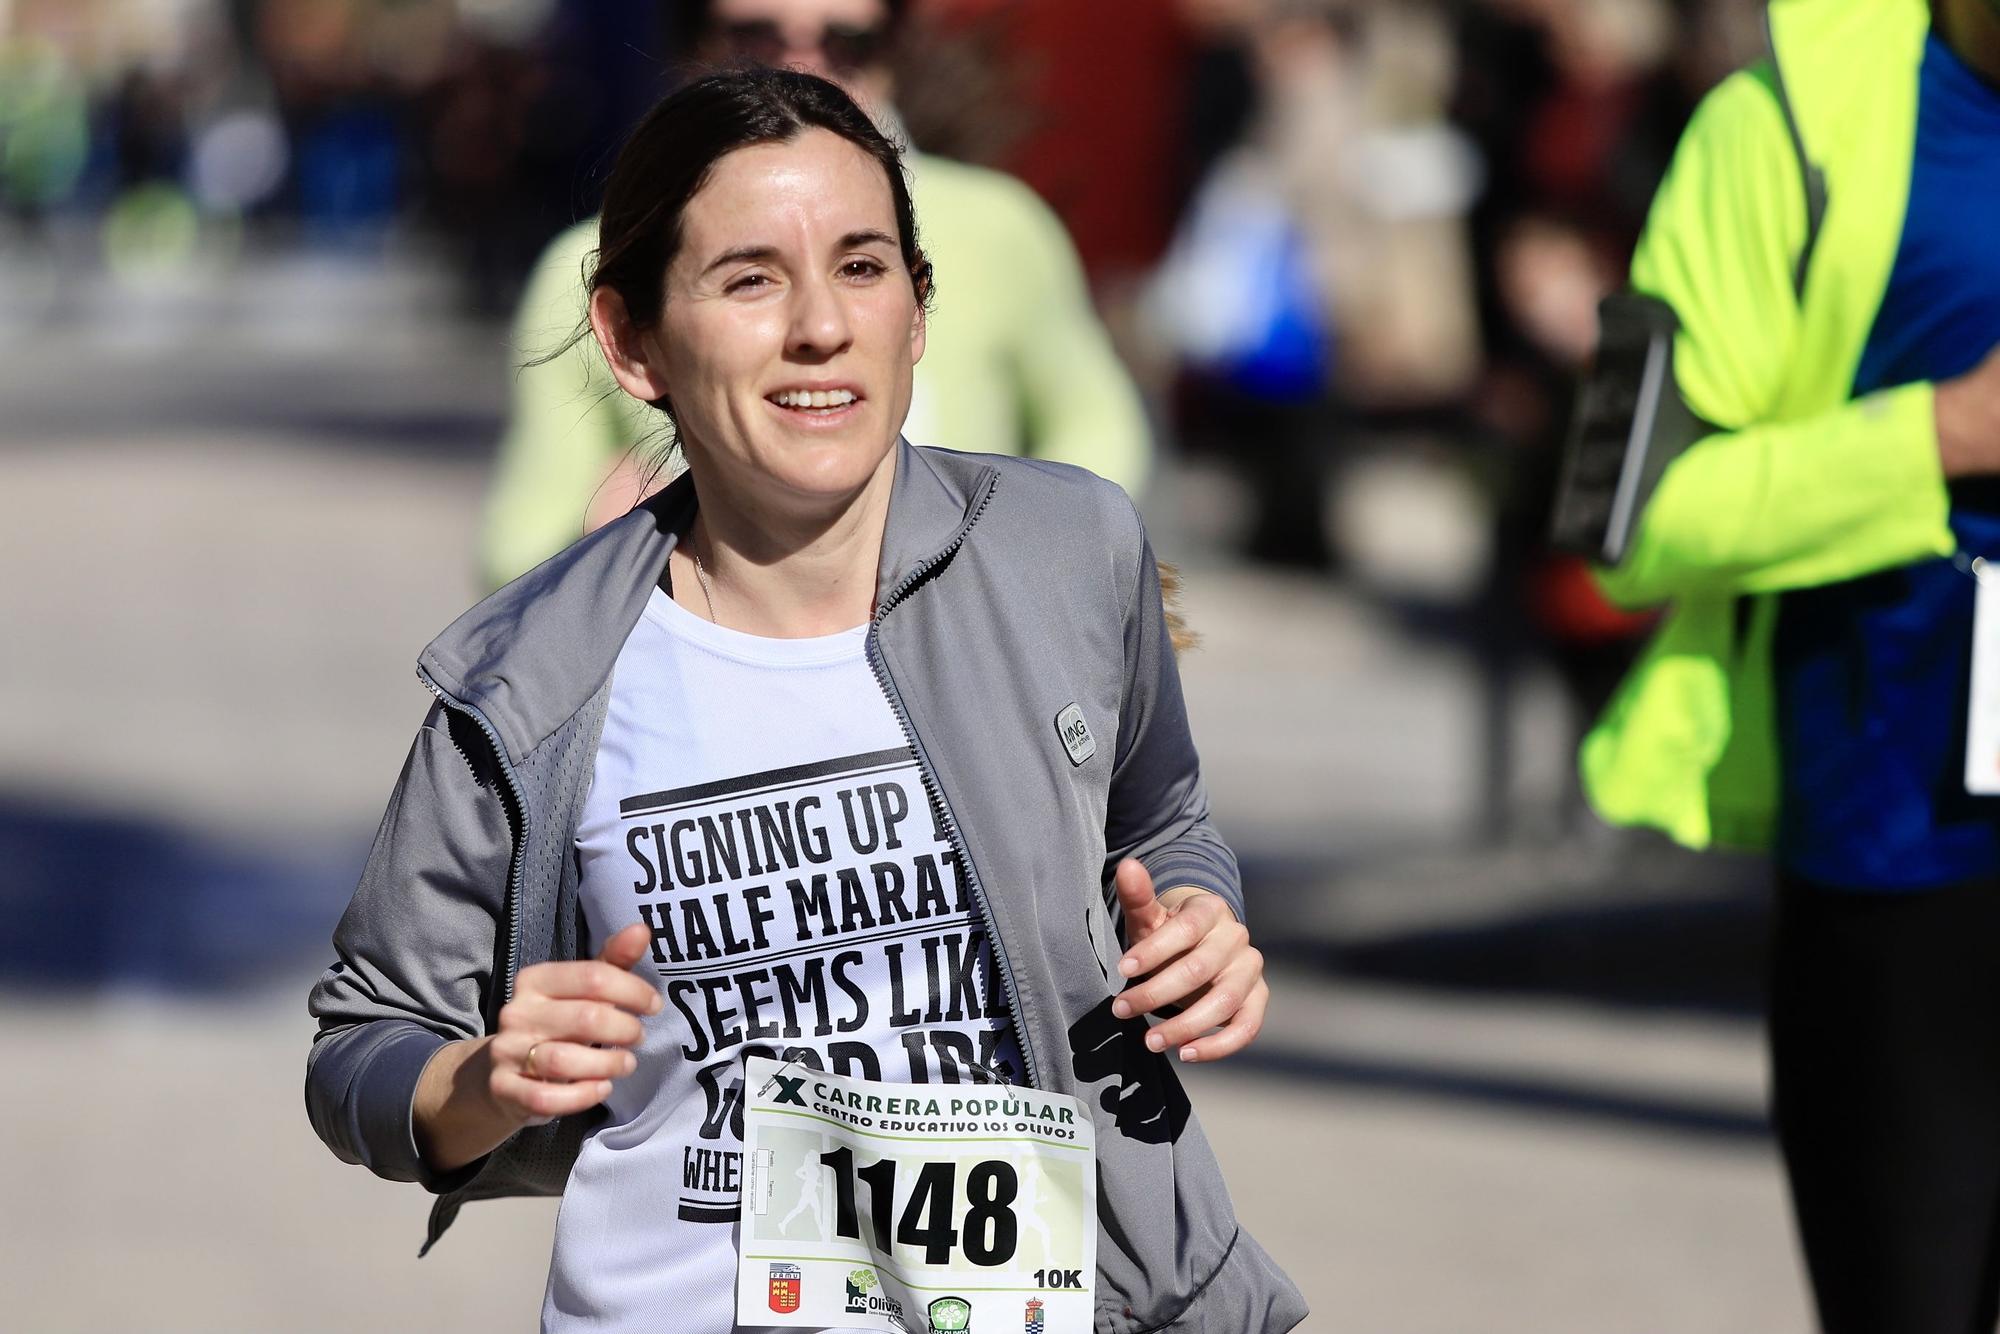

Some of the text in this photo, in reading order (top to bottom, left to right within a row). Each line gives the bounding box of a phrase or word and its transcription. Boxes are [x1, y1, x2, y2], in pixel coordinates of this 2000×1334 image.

[1063, 719, 1087, 745] MNG
[626, 796, 833, 894] SIGNING
[836, 782, 909, 855] UP
[639, 884, 775, 963] HALF
[667, 950, 870, 1062] SEEMS
[771, 1075, 1075, 1125] X CARRERA POPULAR
[813, 1102, 1076, 1140] CENTRO EDUCATIVO LOS OLIVOS
[684, 1145, 742, 1193] WHE
[820, 1146, 1018, 1267] 1148
[1033, 1269, 1083, 1289] 10K
